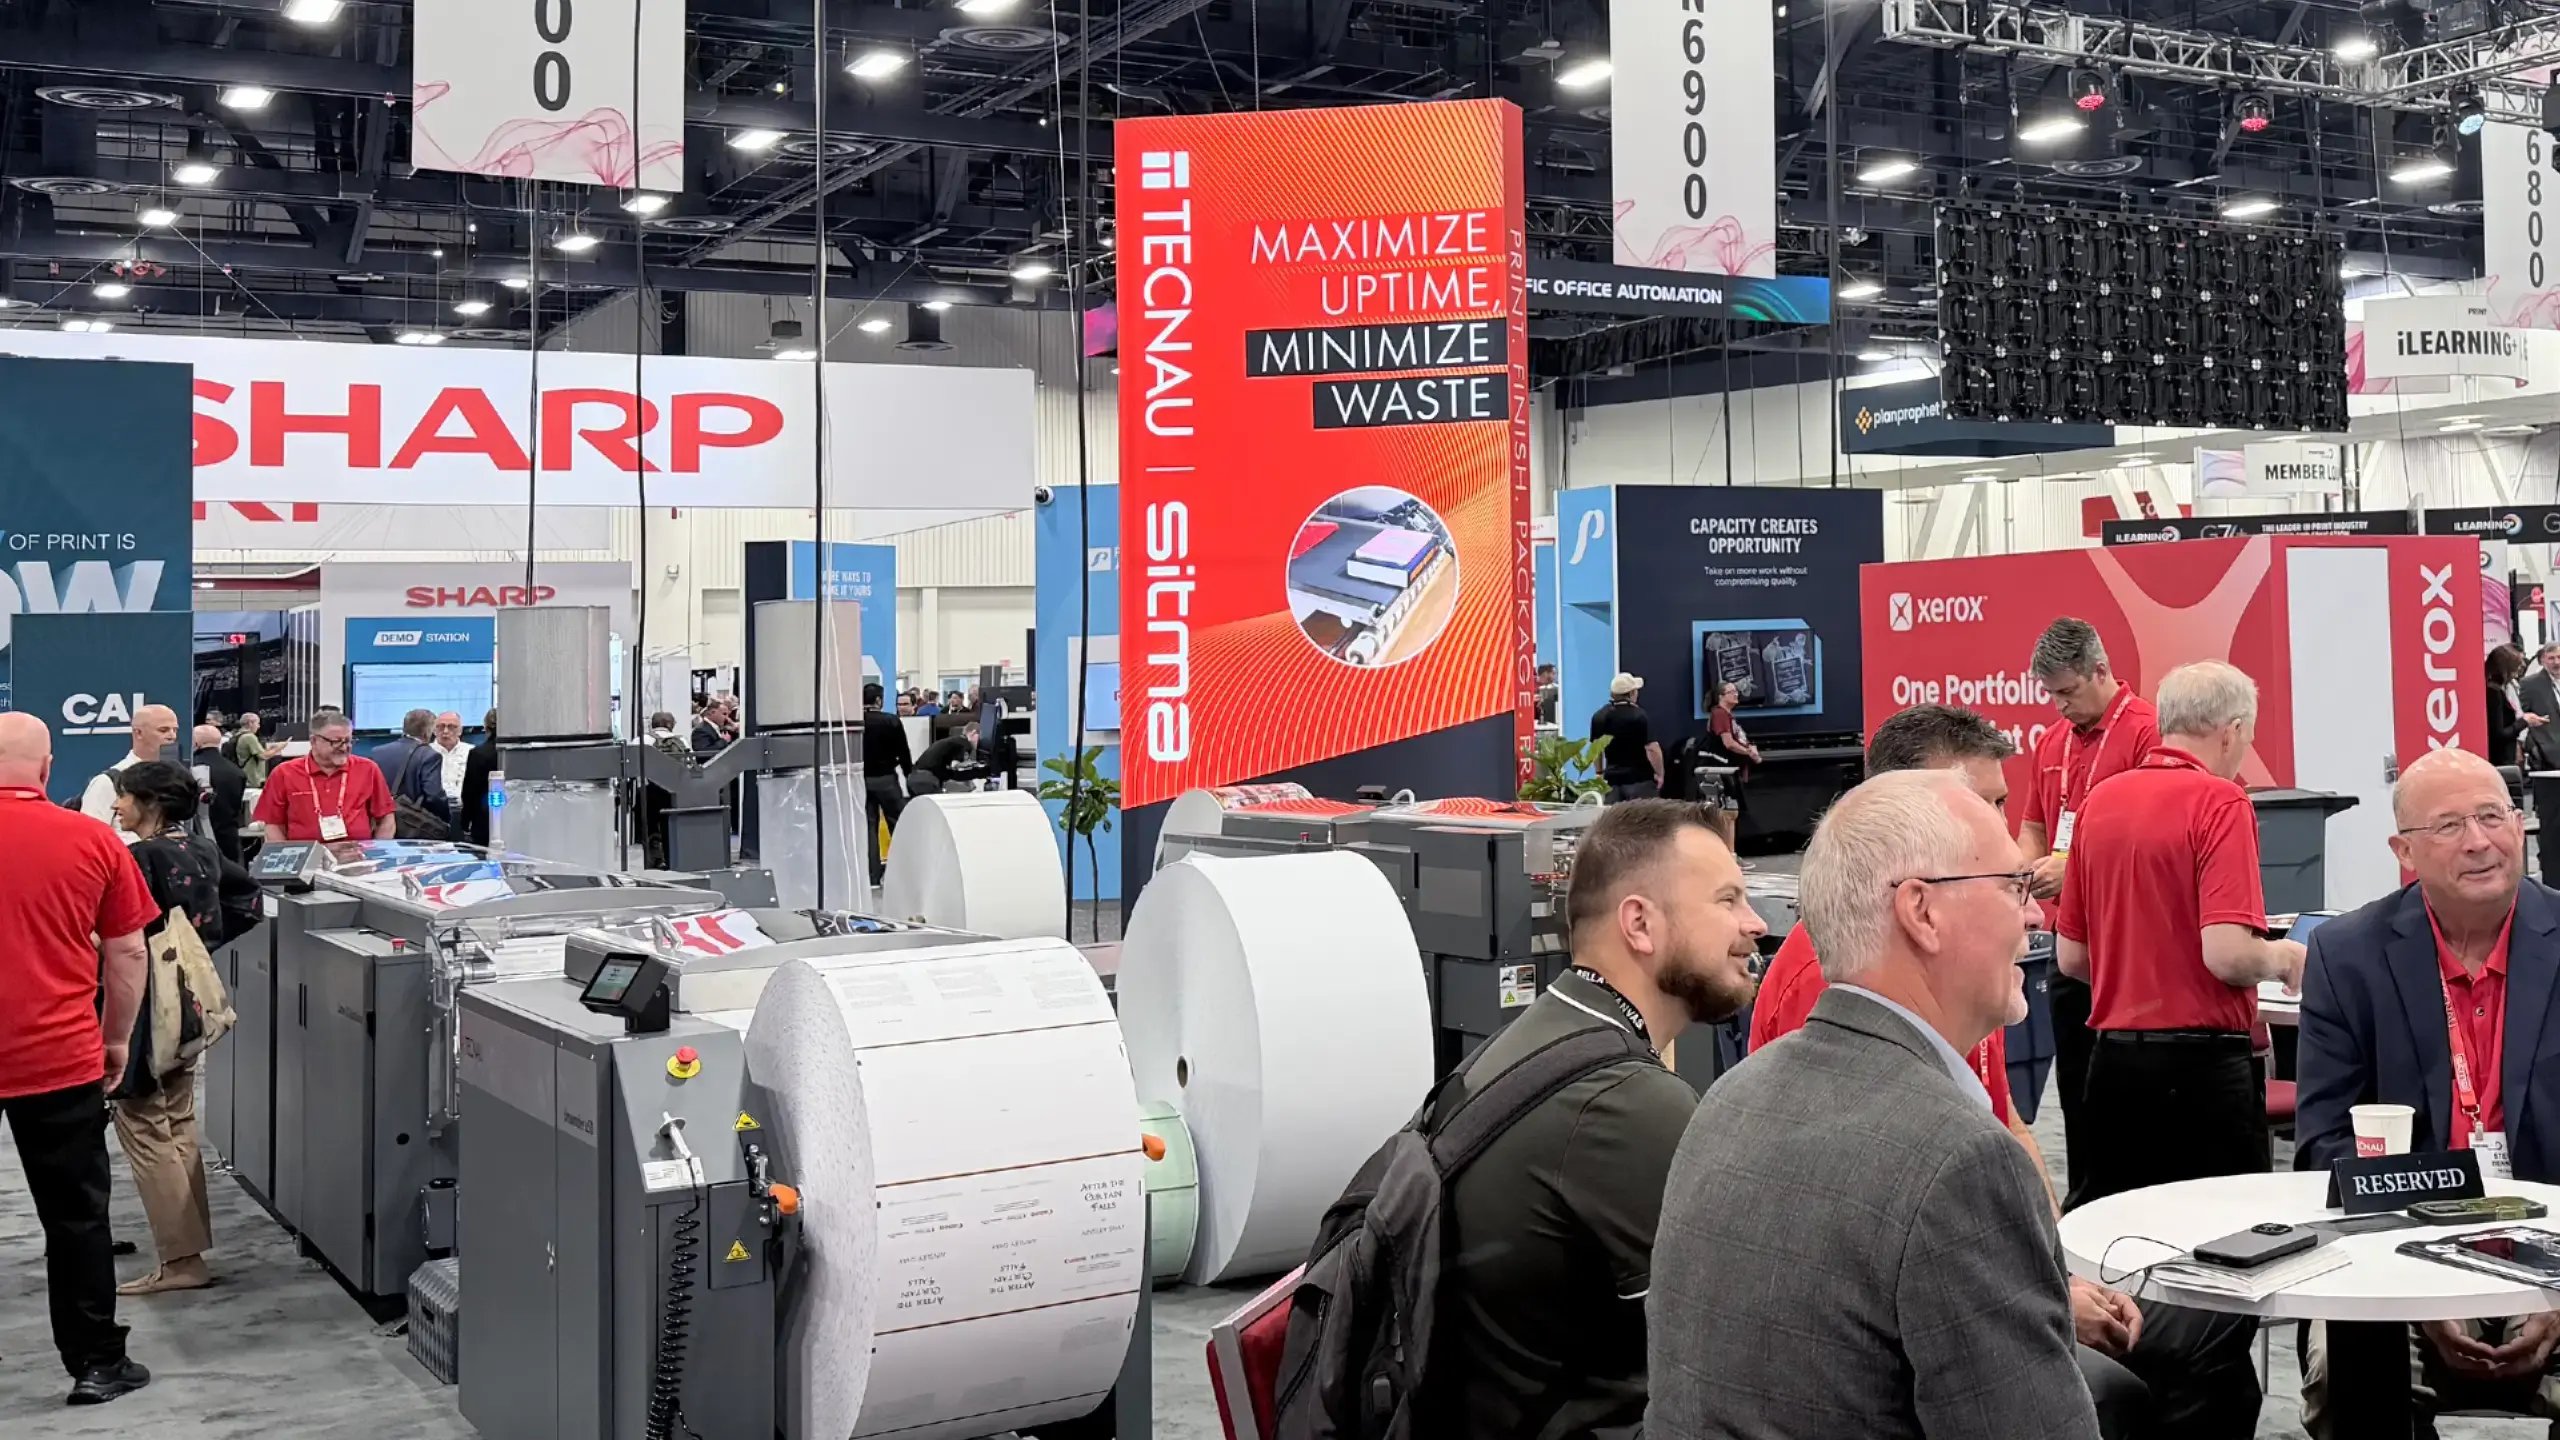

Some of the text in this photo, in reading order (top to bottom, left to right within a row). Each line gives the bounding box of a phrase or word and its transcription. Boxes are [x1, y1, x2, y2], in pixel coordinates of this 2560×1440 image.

[1681, 0, 1707, 219] 6900
[1251, 212, 1487, 264] MAXIMIZE
[1321, 267, 1500, 316] UPTIME,
[1509, 229, 1525, 343] PRINT.
[1553, 279, 1612, 298] OFFICE
[1616, 283, 1722, 304] AUTOMATION
[1261, 322, 1490, 373] MINIMIZE
[1331, 377, 1491, 424] WASTE
[1873, 401, 1940, 429] planprophet
[1513, 364, 1528, 502] FINISH.
[1142, 199, 1196, 762] TECNAU sitma
[2265, 464, 2325, 481] MEMBER
[1690, 518, 1818, 535] CAPACITY CREATES
[9, 534, 136, 550] OF PRINT IS
[1709, 537, 1802, 554] OPPORTUNITY
[406, 586, 556, 608] SHARP
[1917, 596, 1984, 623] xerox
[1516, 520, 1532, 719] PACKAGE.
[380, 632, 470, 643] DEMO STATION
[1893, 675, 1940, 705] One
[2353, 1168, 2466, 1195] RESERVED
